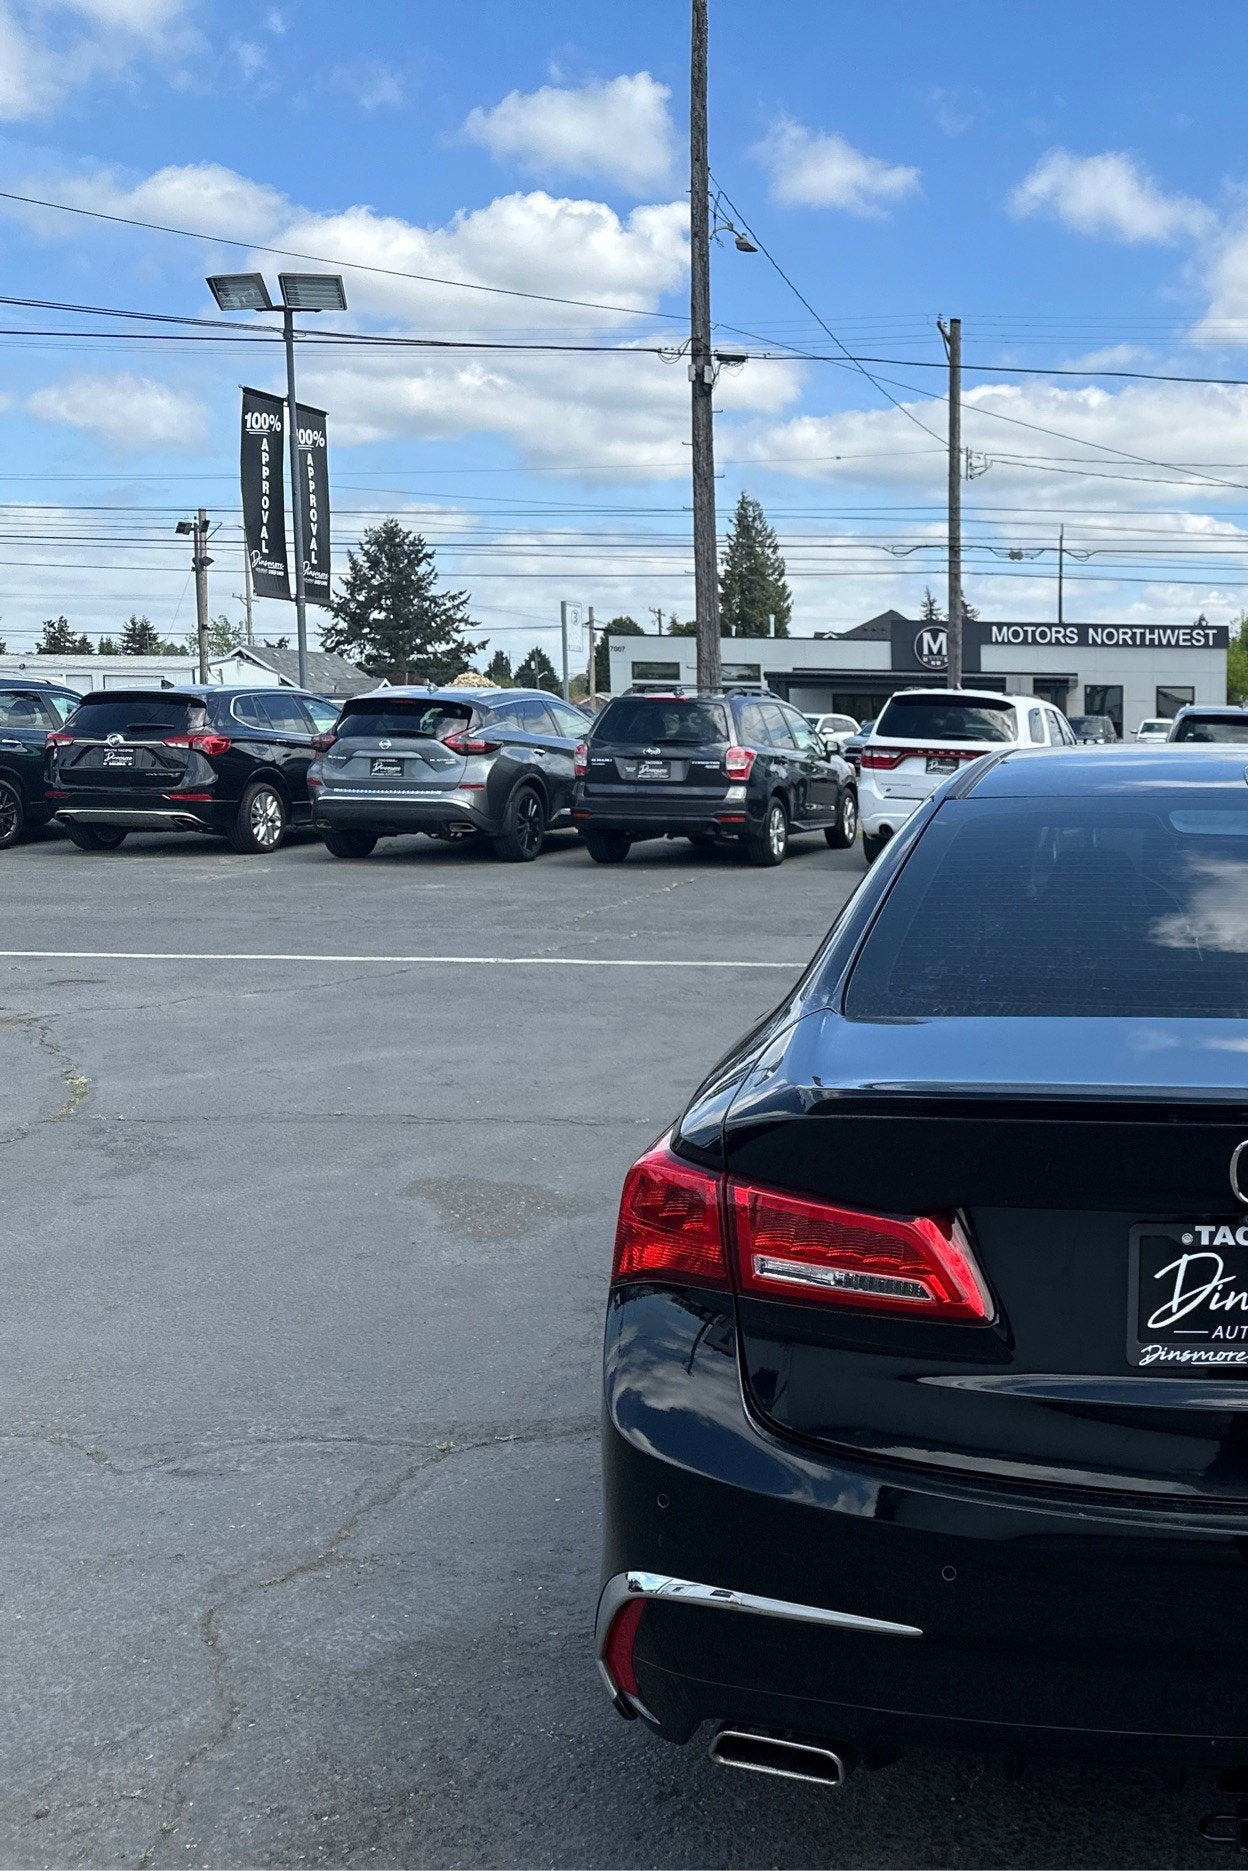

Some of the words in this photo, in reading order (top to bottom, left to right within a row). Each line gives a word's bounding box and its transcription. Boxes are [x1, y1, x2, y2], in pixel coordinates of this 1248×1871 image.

[244, 411, 282, 432] 100%
[260, 437, 270, 554] APPROVAL
[306, 452, 318, 565] APPROVAL
[922, 632, 948, 656] M
[991, 625, 1079, 645] MOTORS
[1088, 627, 1218, 647] NORTHWEST
